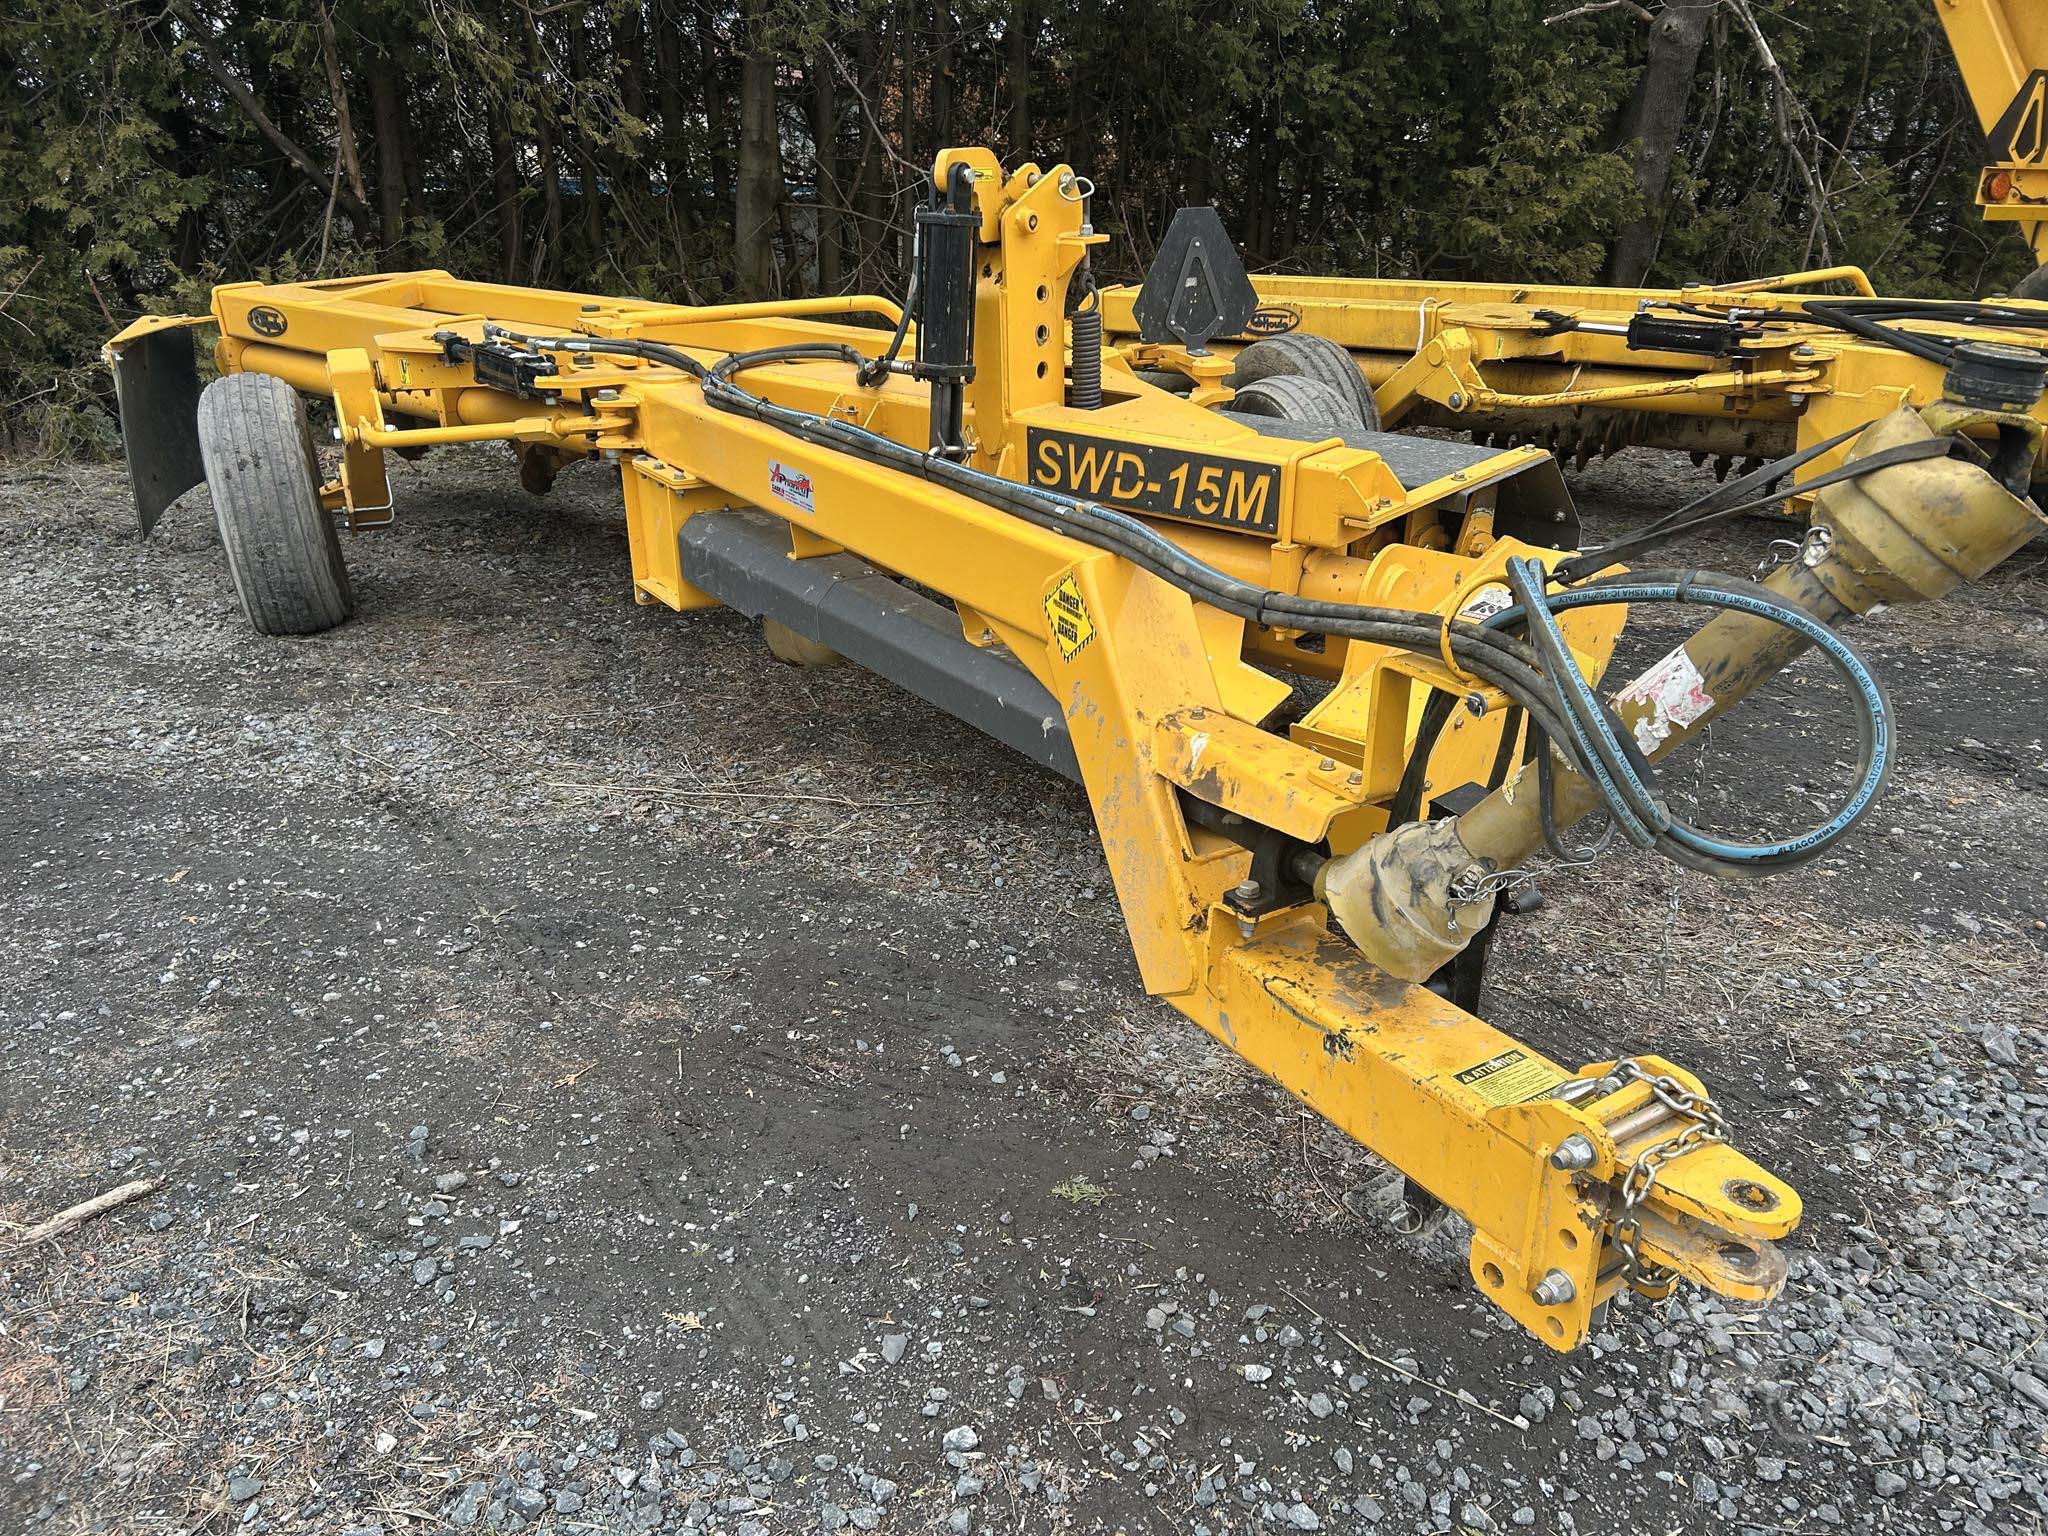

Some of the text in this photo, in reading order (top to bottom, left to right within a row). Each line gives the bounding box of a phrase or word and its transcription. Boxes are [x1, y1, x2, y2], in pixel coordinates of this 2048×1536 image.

[1035, 439, 1271, 524] SWD-15M
[1559, 593, 1580, 604] ITALY
[1622, 588, 1649, 597] MSHA
[1651, 588, 1659, 596] 10
[1662, 587, 1676, 596] DN
[1714, 593, 1727, 601] EN
[1059, 590, 1080, 611] DANGER
[1729, 595, 1751, 607] R2AT
[1753, 602, 1767, 611] 100
[1058, 622, 1078, 644] DANGER
[1829, 641, 1849, 659] MPa
[1858, 675, 1872, 690] WP
[1579, 685, 1590, 698] WP
[1595, 760, 1610, 781] MPa
[1864, 751, 1884, 789] 2AT/2SN
[1615, 799, 1627, 814] WP
[1839, 791, 1870, 824] FLEXOR
[1472, 1053, 1523, 1080] ATTENTION
